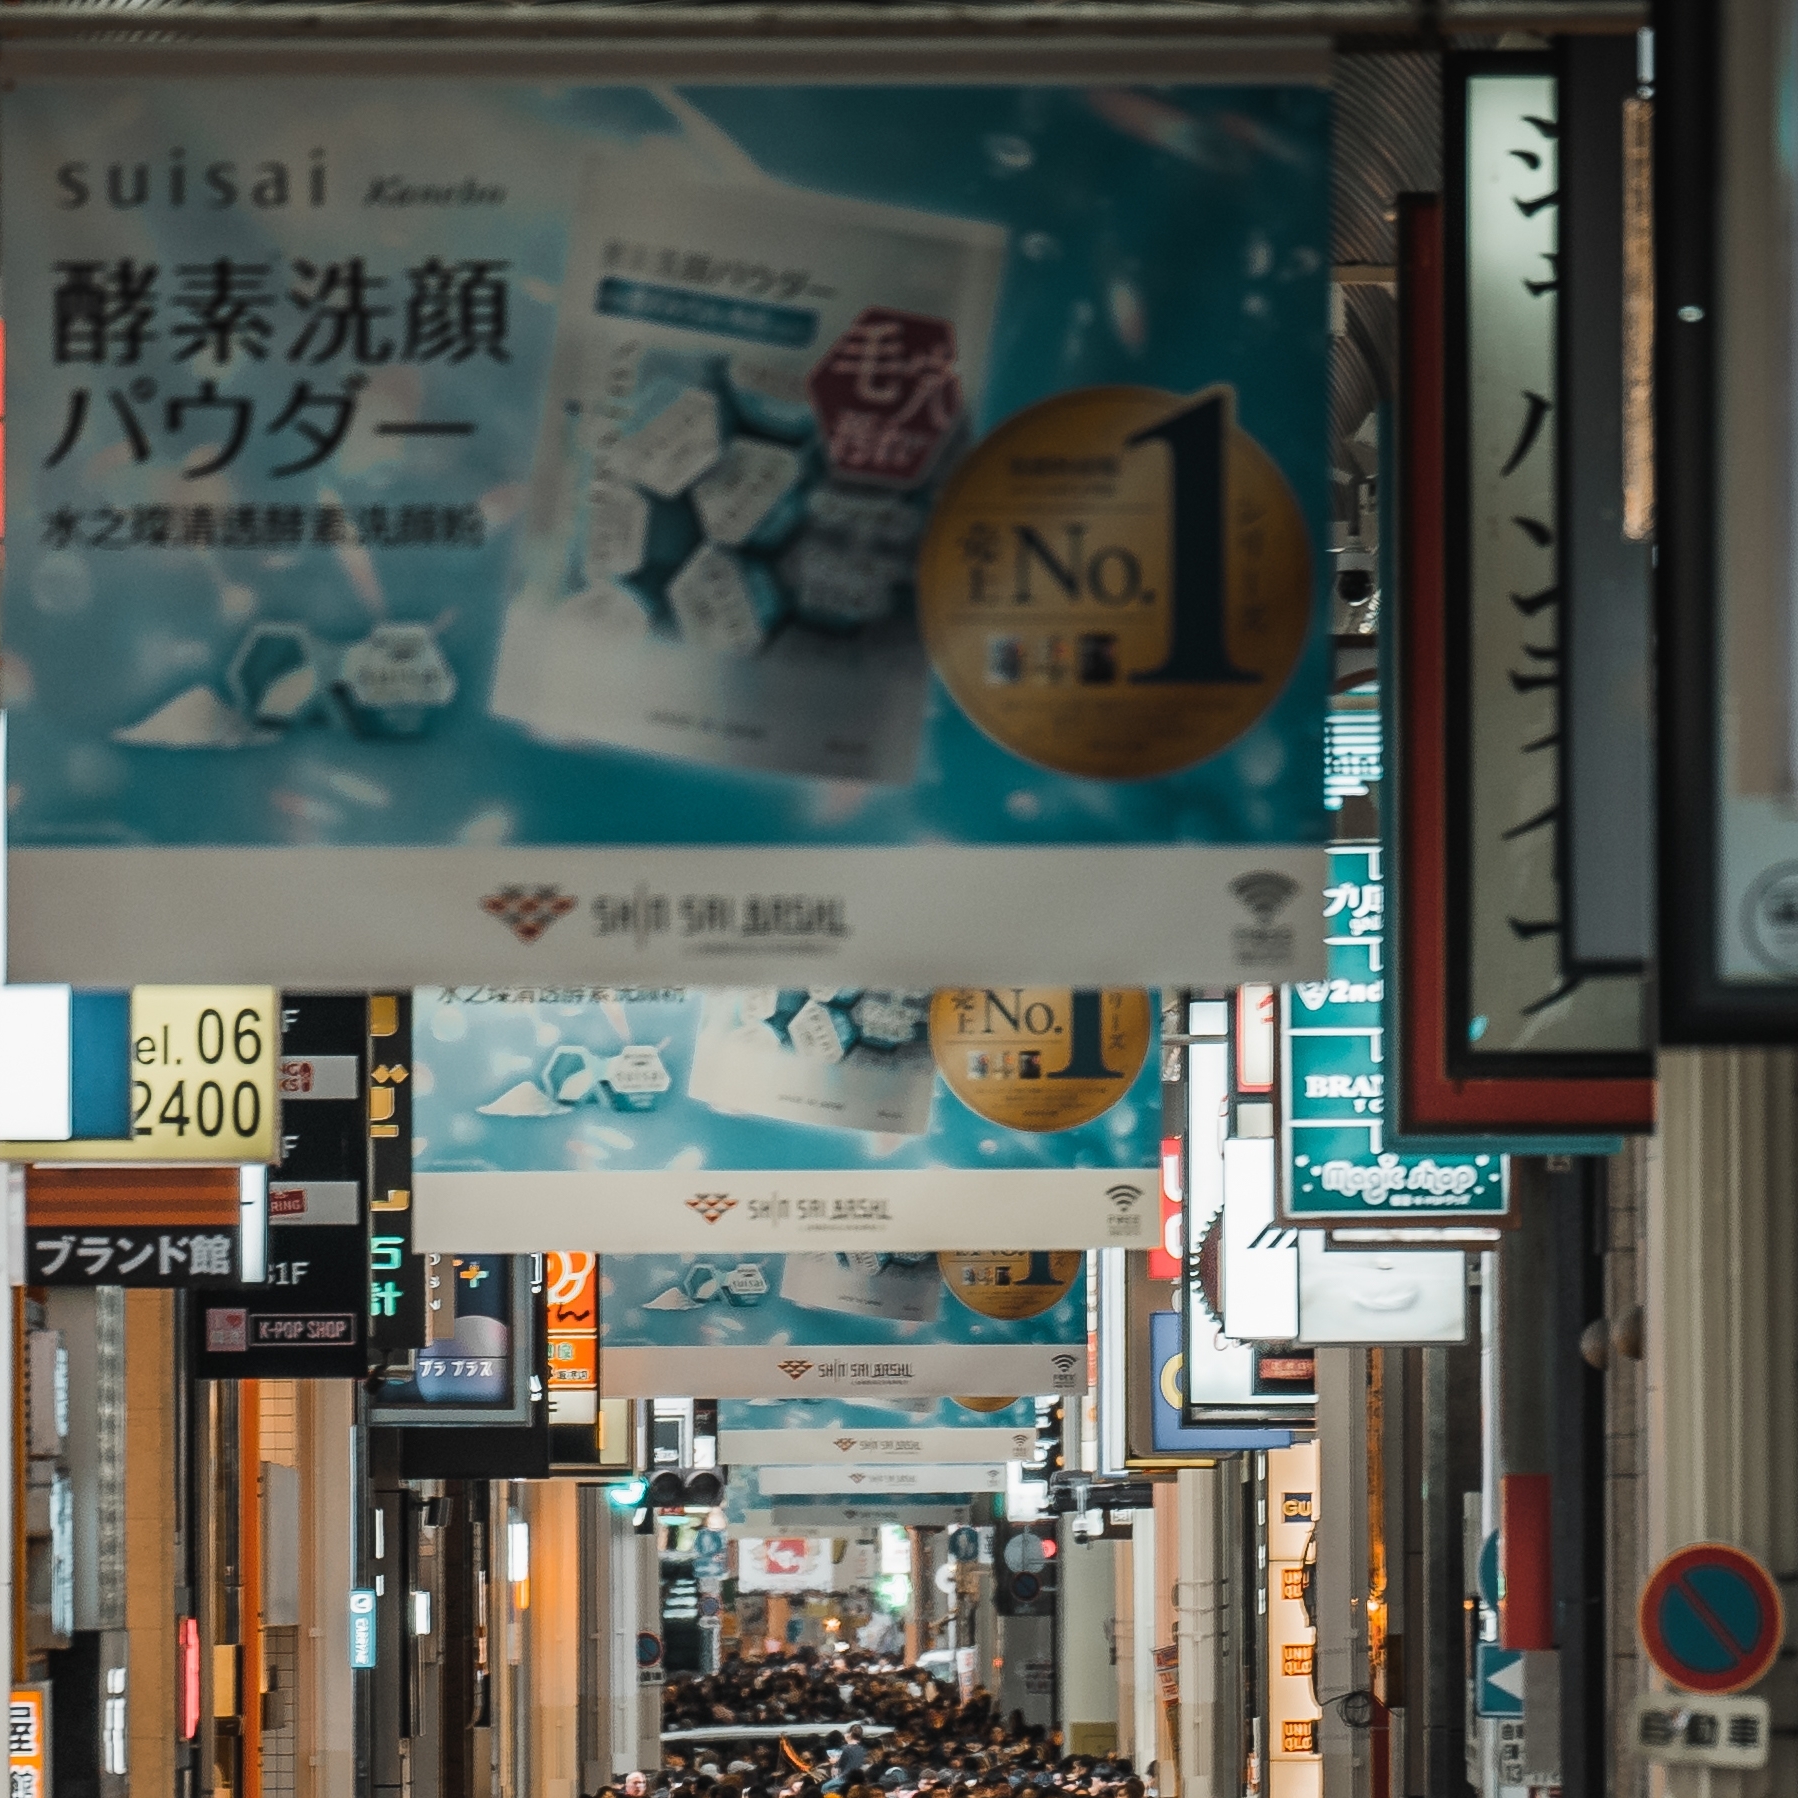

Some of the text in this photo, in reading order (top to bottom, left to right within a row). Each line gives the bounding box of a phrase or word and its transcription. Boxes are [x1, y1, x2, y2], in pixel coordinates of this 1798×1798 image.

[54, 147, 327, 209] suisai
[51, 256, 512, 365] 酵素洗顔
[44, 373, 478, 482] パウダー
[1014, 523, 1158, 608] No.
[1124, 390, 1265, 685] 1
[983, 989, 1064, 1035] No.
[198, 1008, 262, 1065] 06
[133, 1080, 262, 1137] 2400
[34, 1233, 231, 1276] ブランド館
[259, 1320, 303, 1339] K-POP
[306, 1320, 347, 1339] SHOP
[1282, 1500, 1312, 1517] GU
[1284, 1647, 1311, 1660] UNI
[1284, 1661, 1312, 1675] QLO
[1284, 1723, 1311, 1736] UNI
[1284, 1737, 1312, 1750] QLO
